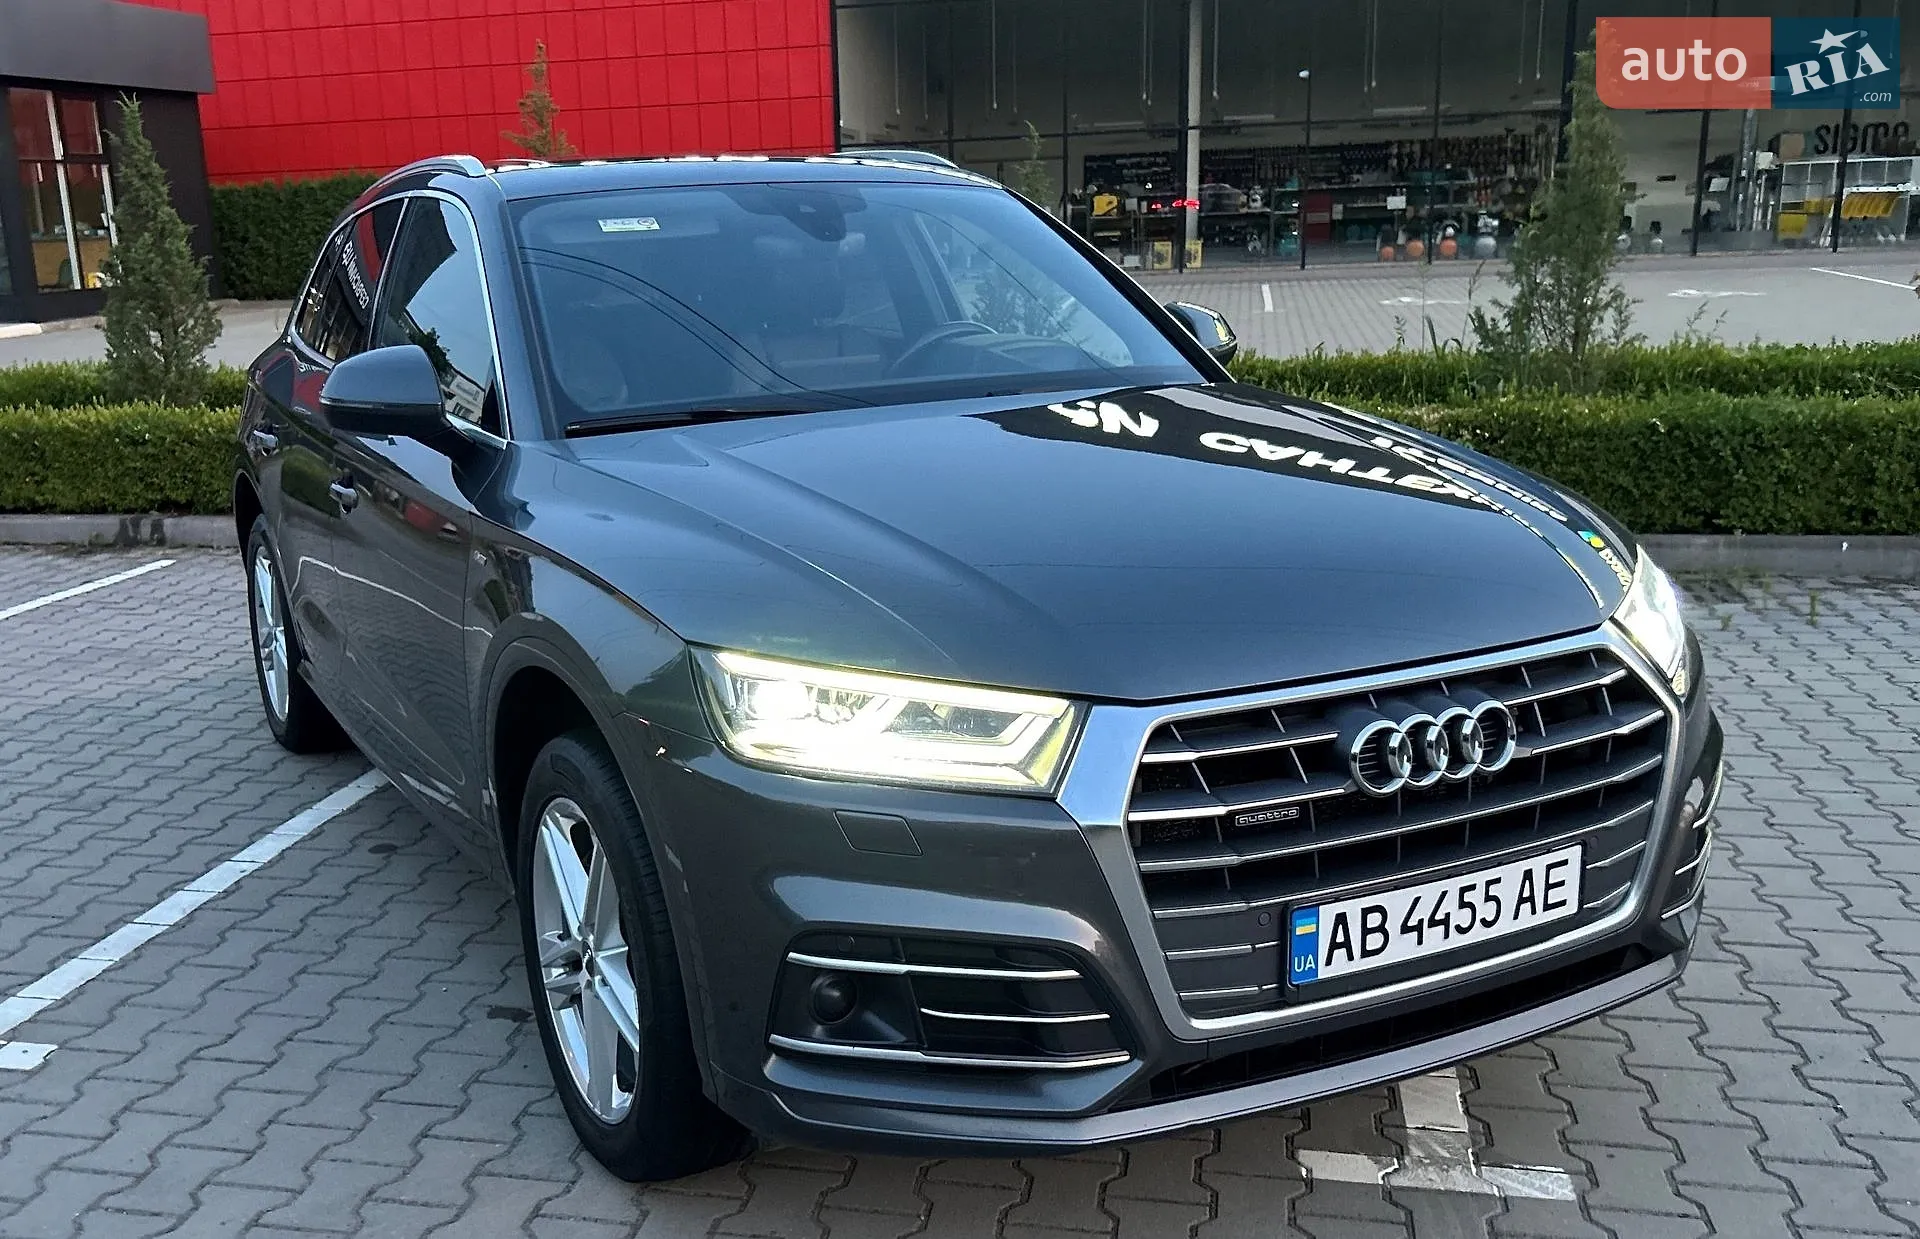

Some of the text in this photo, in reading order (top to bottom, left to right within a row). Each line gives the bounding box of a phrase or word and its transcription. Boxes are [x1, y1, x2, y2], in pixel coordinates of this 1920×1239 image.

[1238, 809, 1298, 825] quattro
[1324, 858, 1571, 966] AB 4455 AE
[1294, 954, 1316, 972] UA
